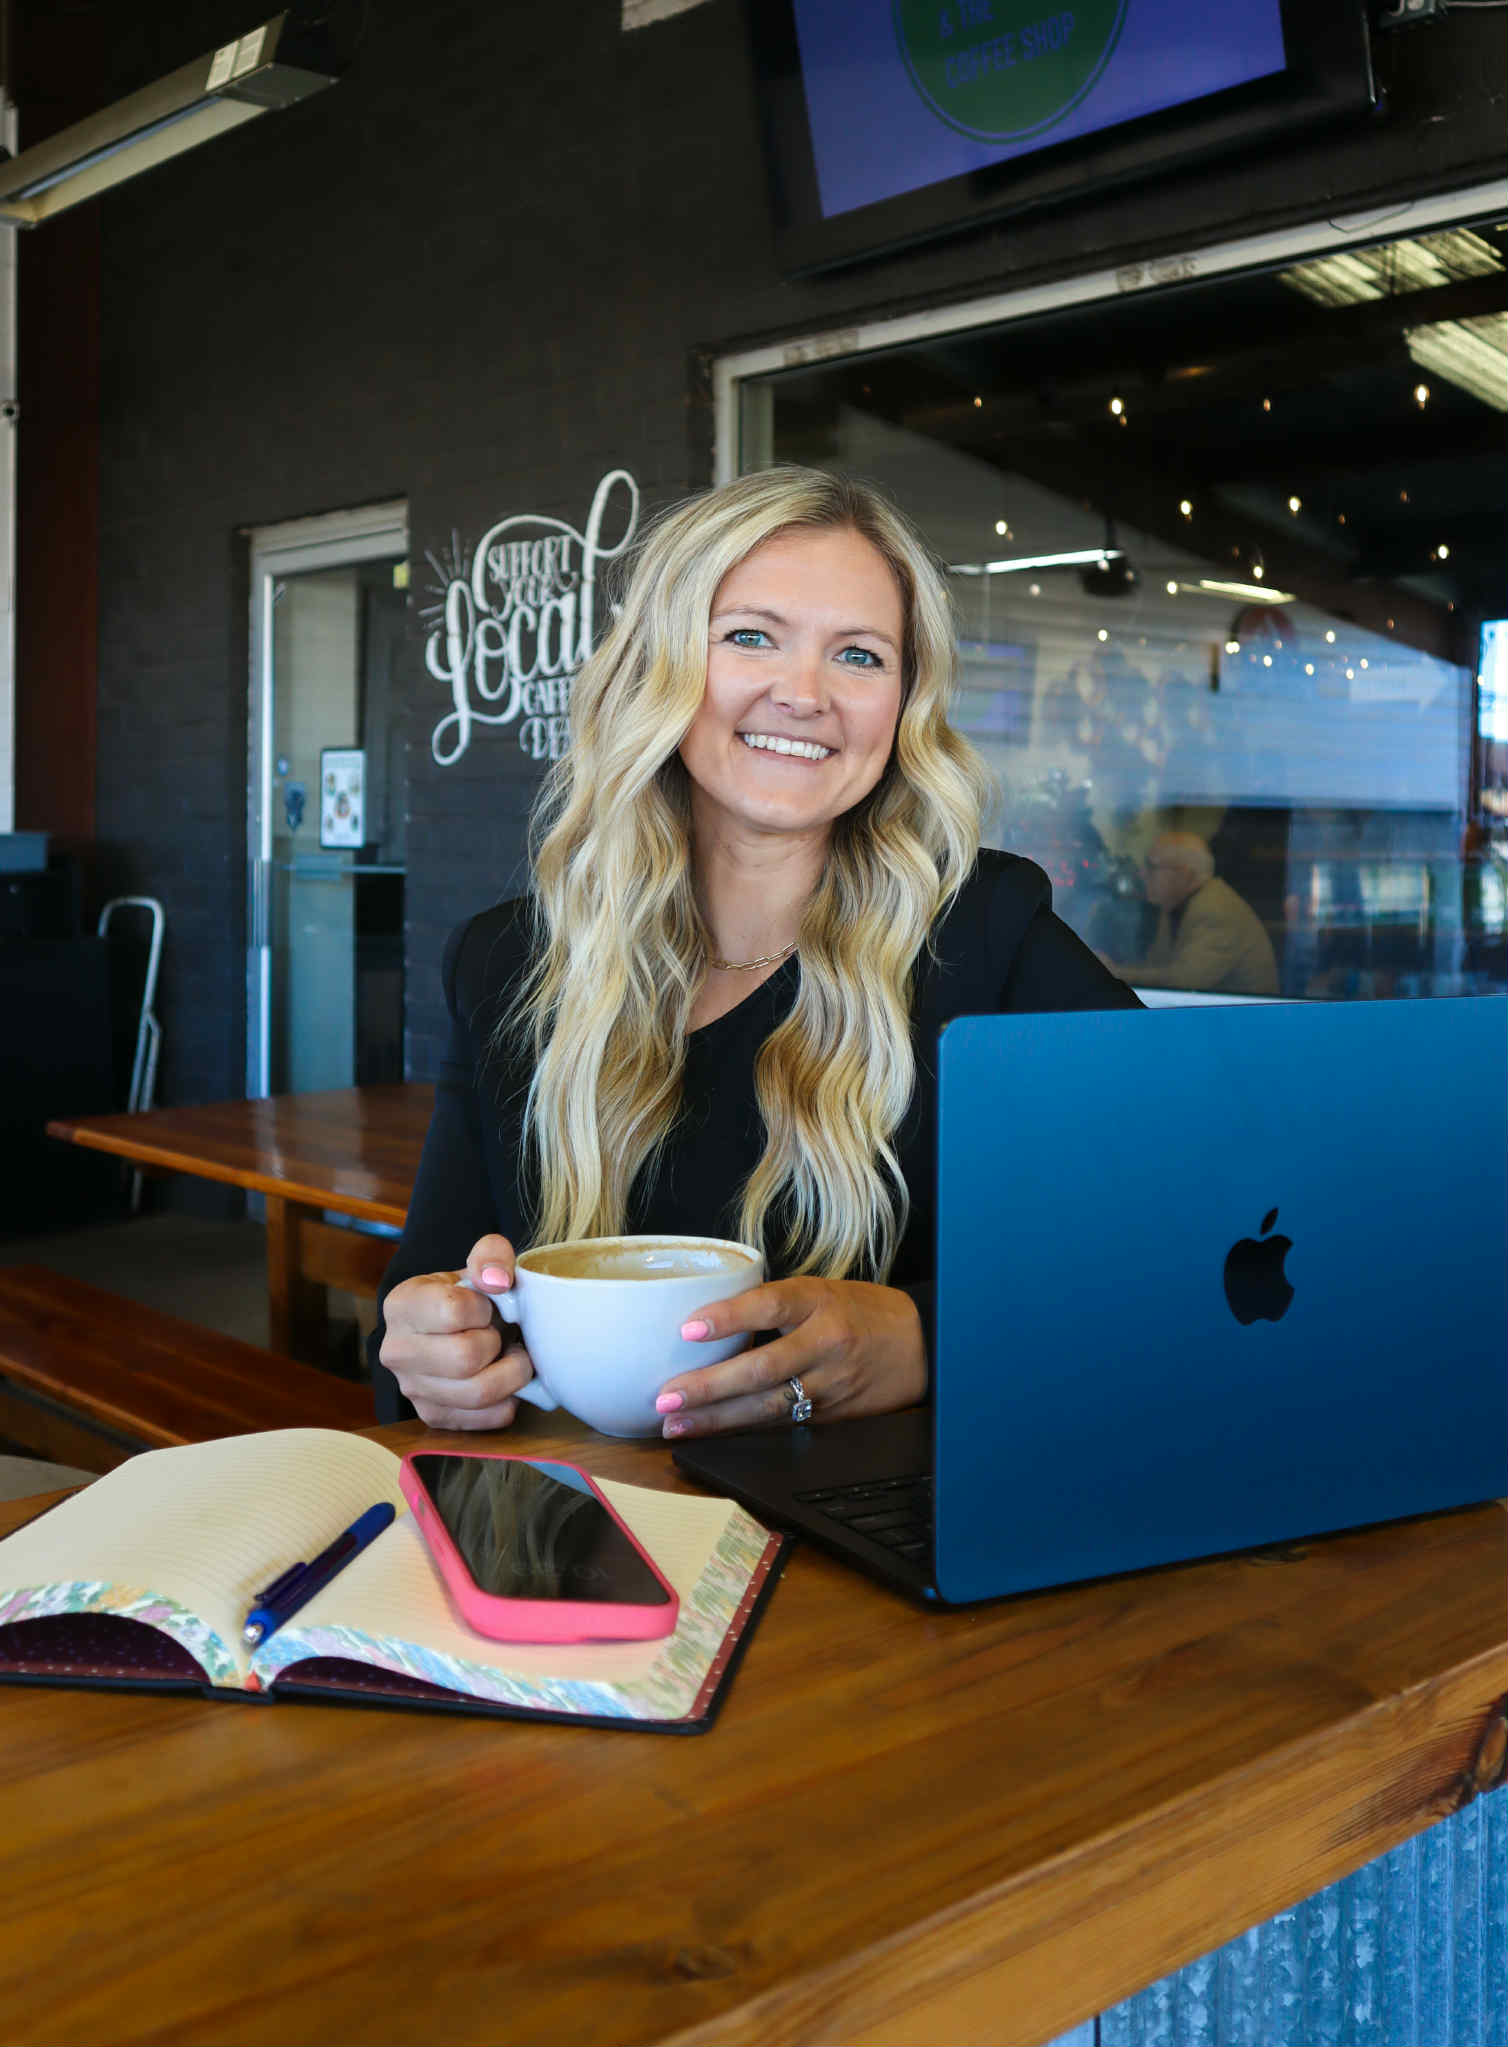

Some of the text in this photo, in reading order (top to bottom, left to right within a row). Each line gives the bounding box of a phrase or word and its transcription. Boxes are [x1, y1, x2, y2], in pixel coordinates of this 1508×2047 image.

[944, 10, 1075, 88] COFFEE SHOP
[488, 534, 578, 592] SUPPORT
